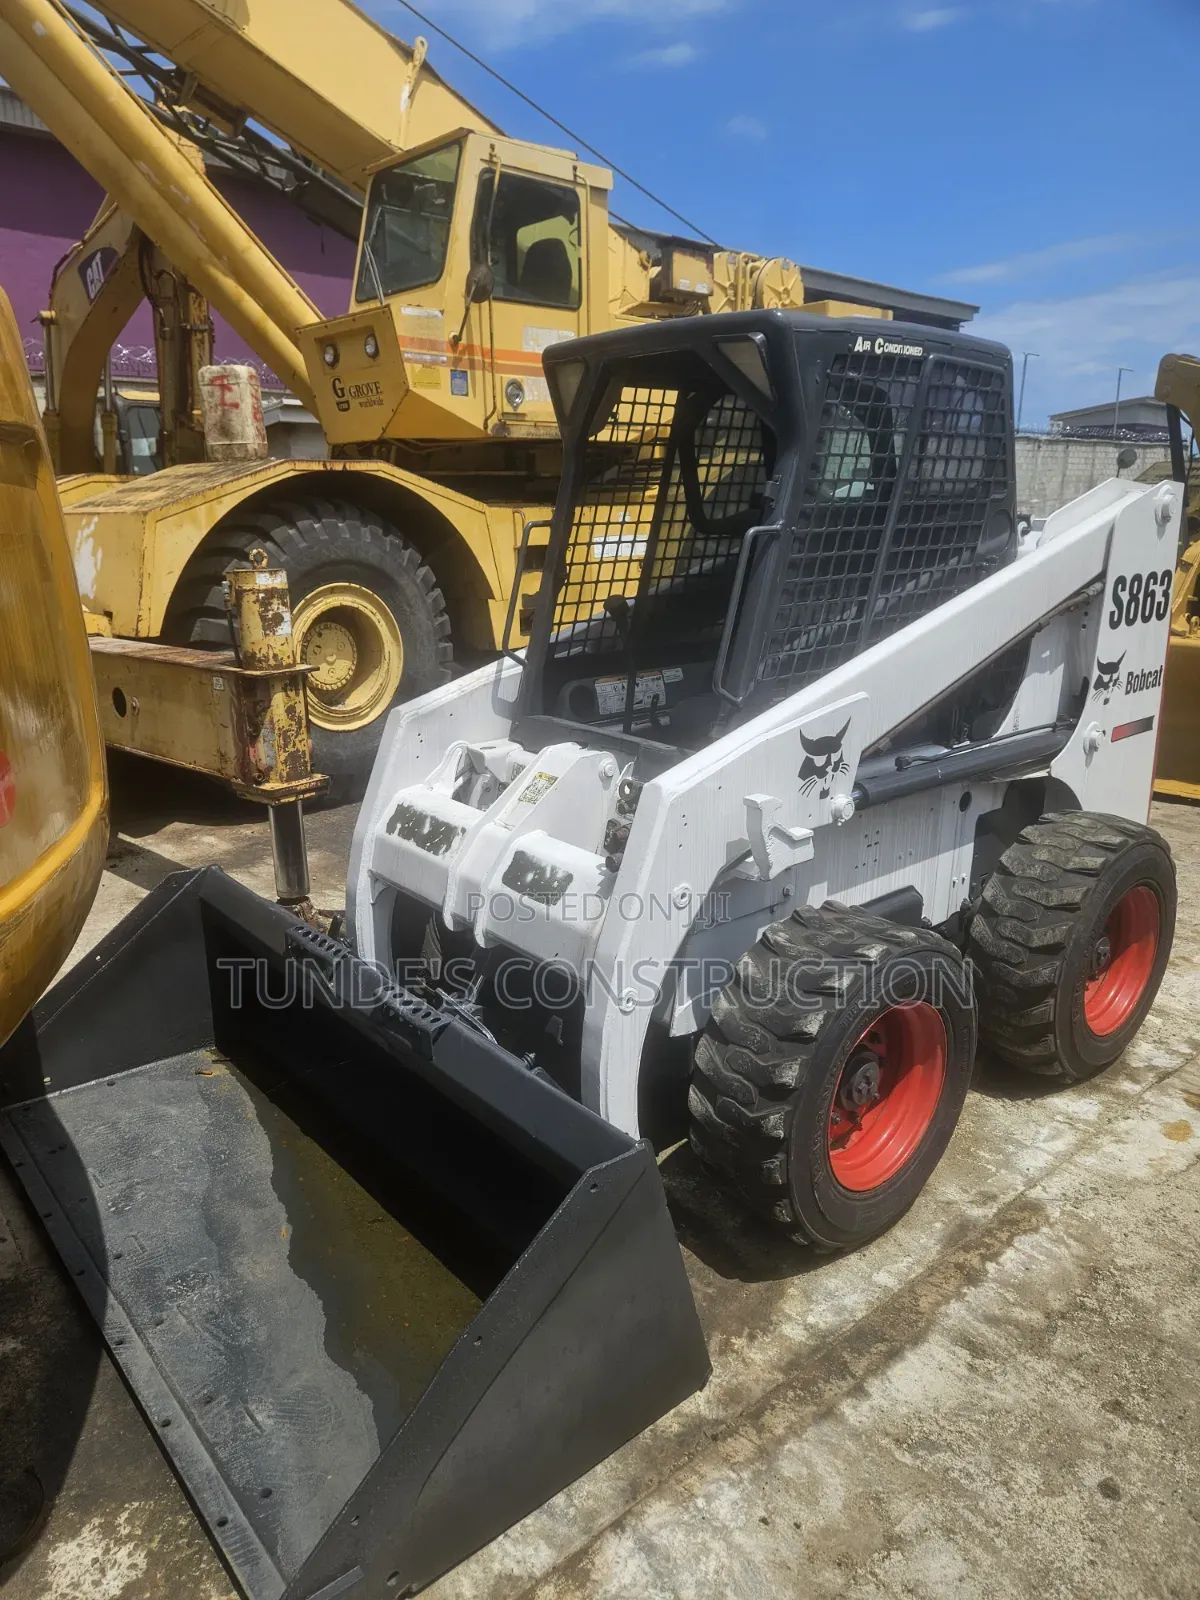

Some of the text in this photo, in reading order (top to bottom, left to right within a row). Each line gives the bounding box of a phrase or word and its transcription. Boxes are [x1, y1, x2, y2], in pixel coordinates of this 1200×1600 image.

[86, 250, 105, 300] CAT
[348, 381, 382, 399] GROVE
[1108, 569, 1173, 630] S863
[1124, 664, 1164, 696] Bobcat
